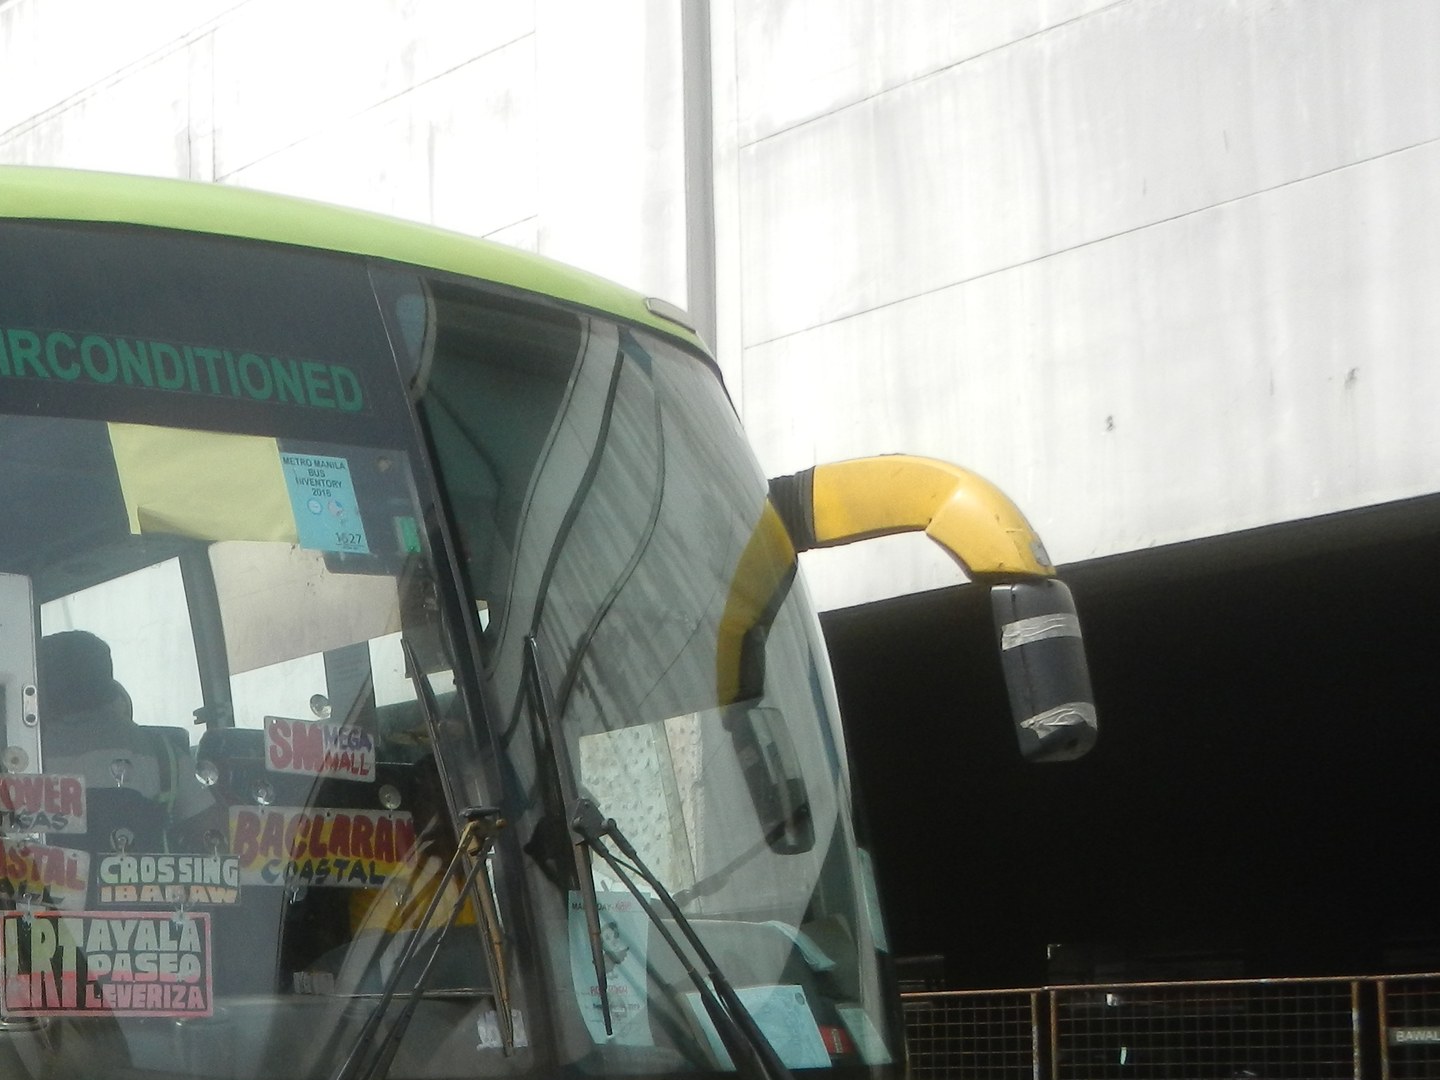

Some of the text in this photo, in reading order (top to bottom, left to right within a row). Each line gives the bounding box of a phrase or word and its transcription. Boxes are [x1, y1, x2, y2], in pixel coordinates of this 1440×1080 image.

[282, 456, 346, 470] METRO MANILA
[308, 468, 326, 478] BUS
[295, 477, 343, 489] INVENTORY
[267, 719, 325, 773] SM
[323, 725, 373, 752] MEGA
[323, 751, 371, 776] MALL
[233, 810, 417, 869] BACLARAN
[100, 856, 240, 886] CROSSING
[261, 858, 387, 886] COASTAL
[85, 918, 203, 953] AYALA
[4, 918, 84, 1009] LRT
[86, 952, 203, 984] PASEO
[85, 983, 208, 1010] LEVERIZA
